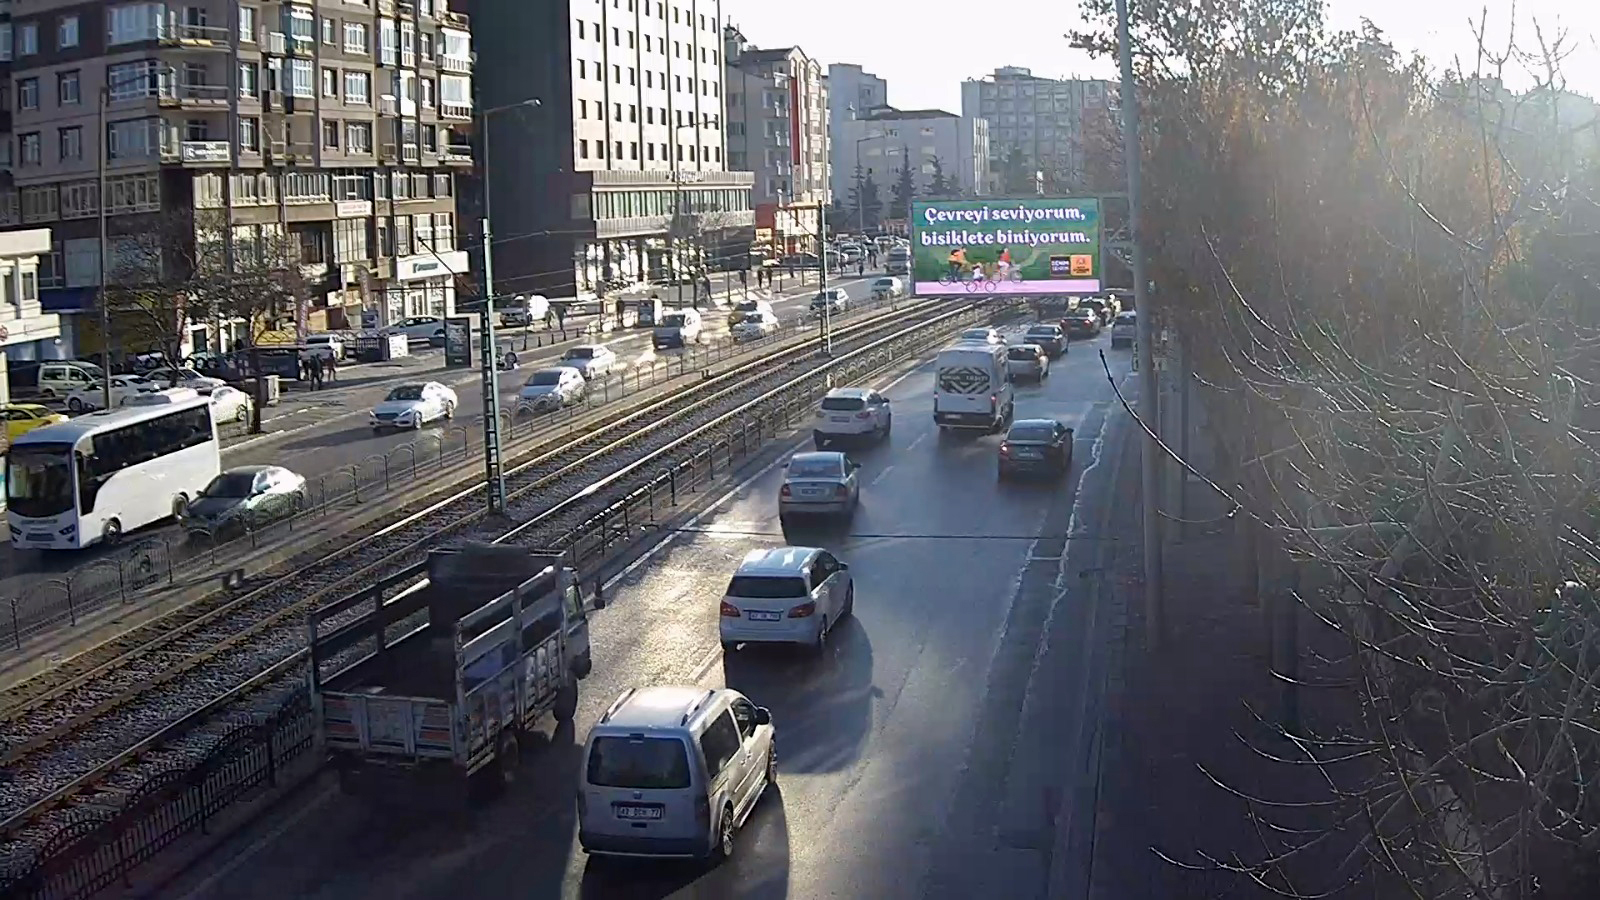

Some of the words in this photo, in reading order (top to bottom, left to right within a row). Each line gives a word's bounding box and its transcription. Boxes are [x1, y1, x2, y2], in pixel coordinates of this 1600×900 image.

[924, 206, 989, 225] Çevreyi
[992, 205, 1086, 224] seviyorum,
[921, 230, 994, 246] bisiklete
[996, 229, 1091, 248] biniyorum.
